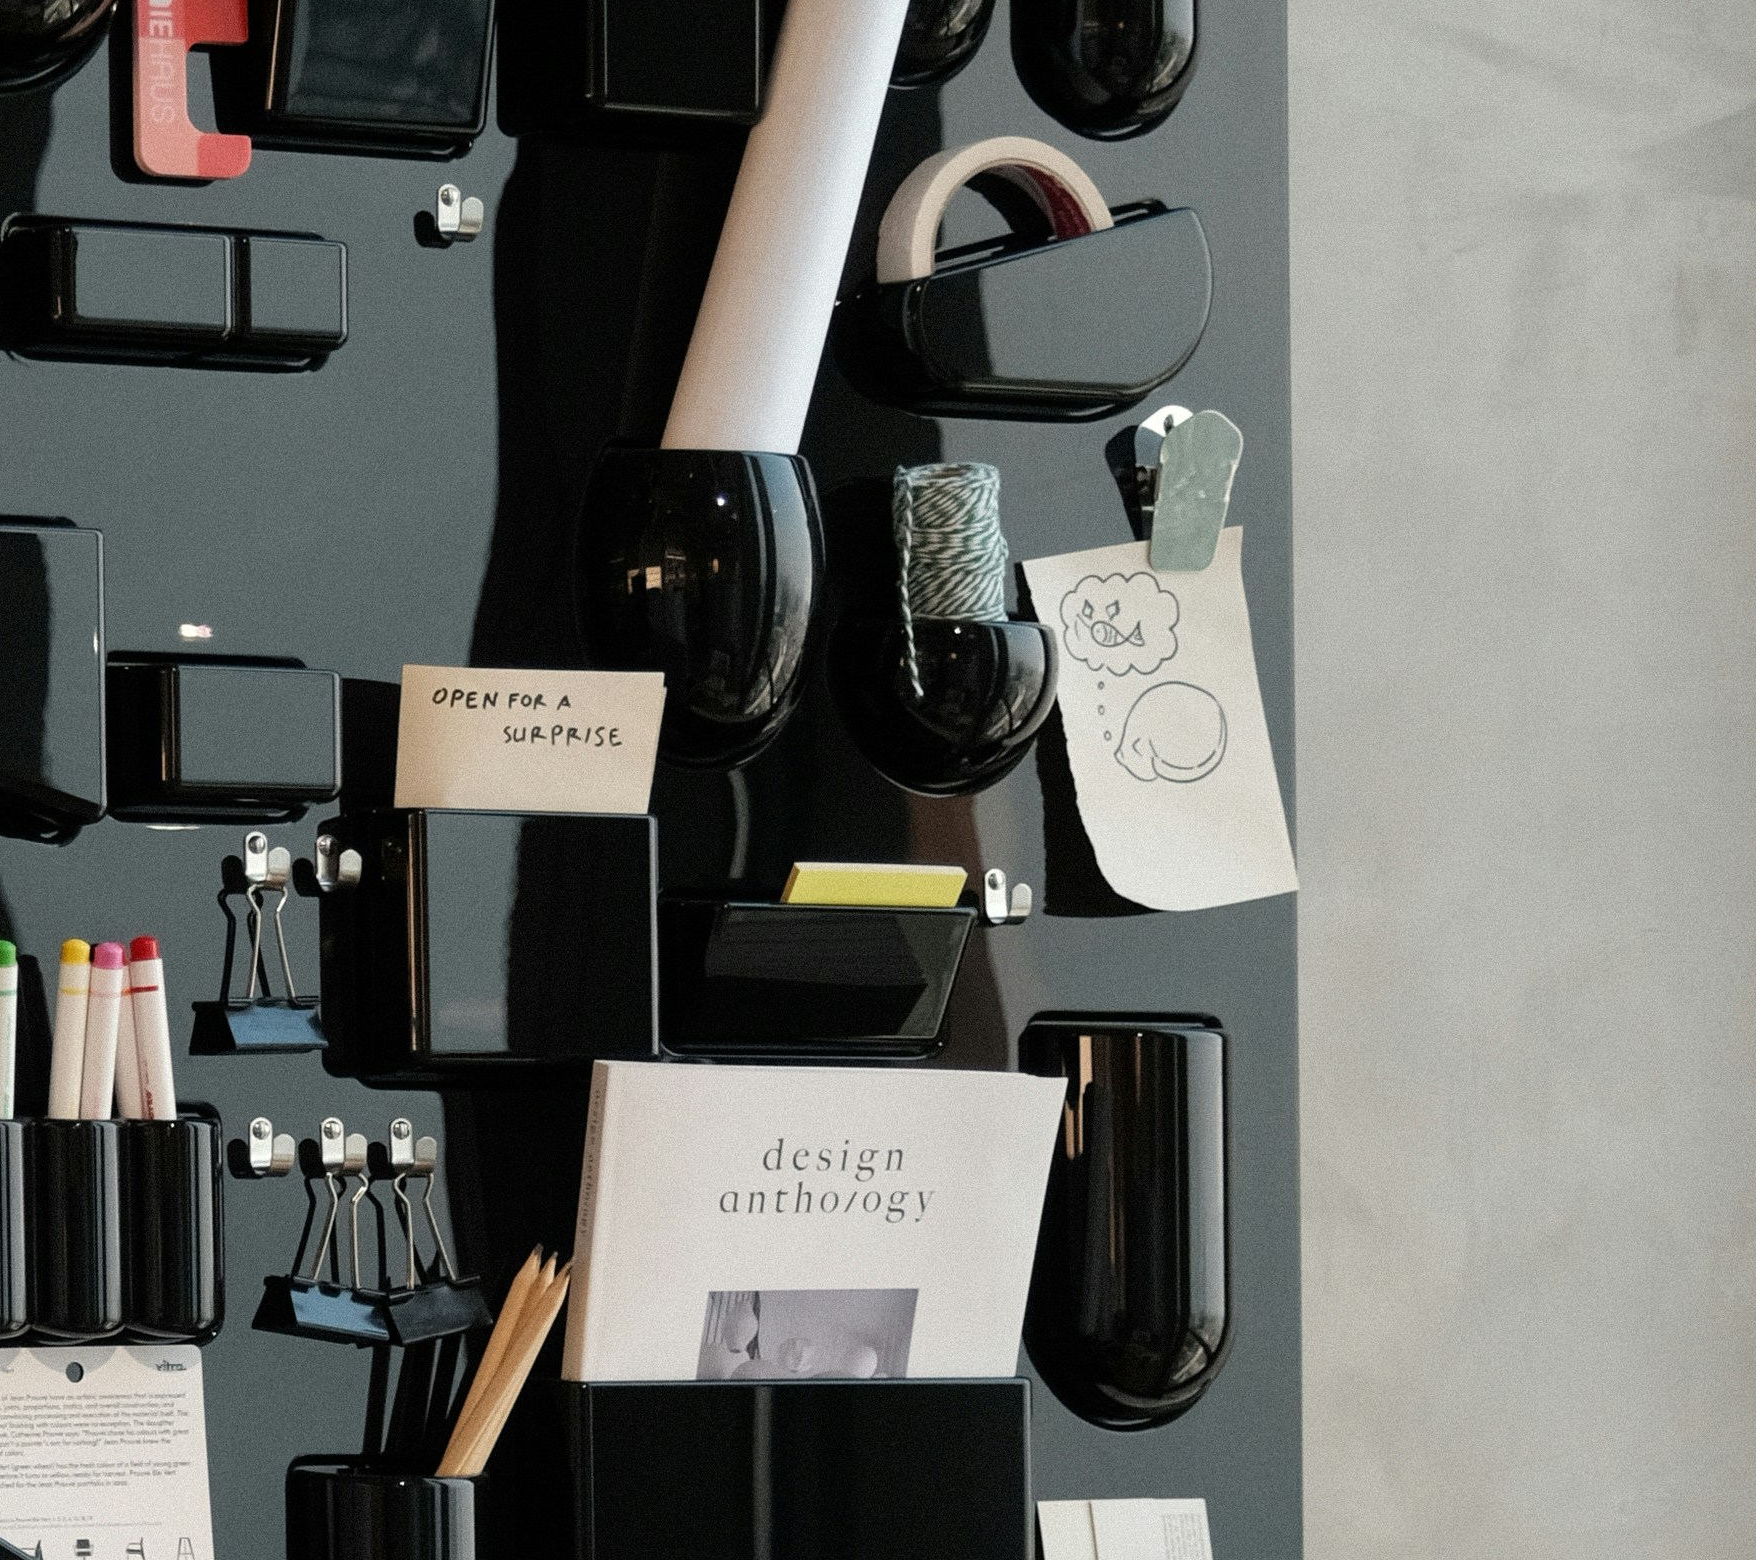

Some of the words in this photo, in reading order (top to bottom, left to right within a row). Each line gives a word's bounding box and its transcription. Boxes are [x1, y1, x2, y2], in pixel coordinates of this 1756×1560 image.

[432, 688, 499, 711] OPEN
[507, 690, 546, 710] FOR
[556, 693, 571, 710] A
[503, 724, 624, 748] SURPRISE
[761, 1136, 906, 1184] design
[717, 1179, 936, 1225] anthology
